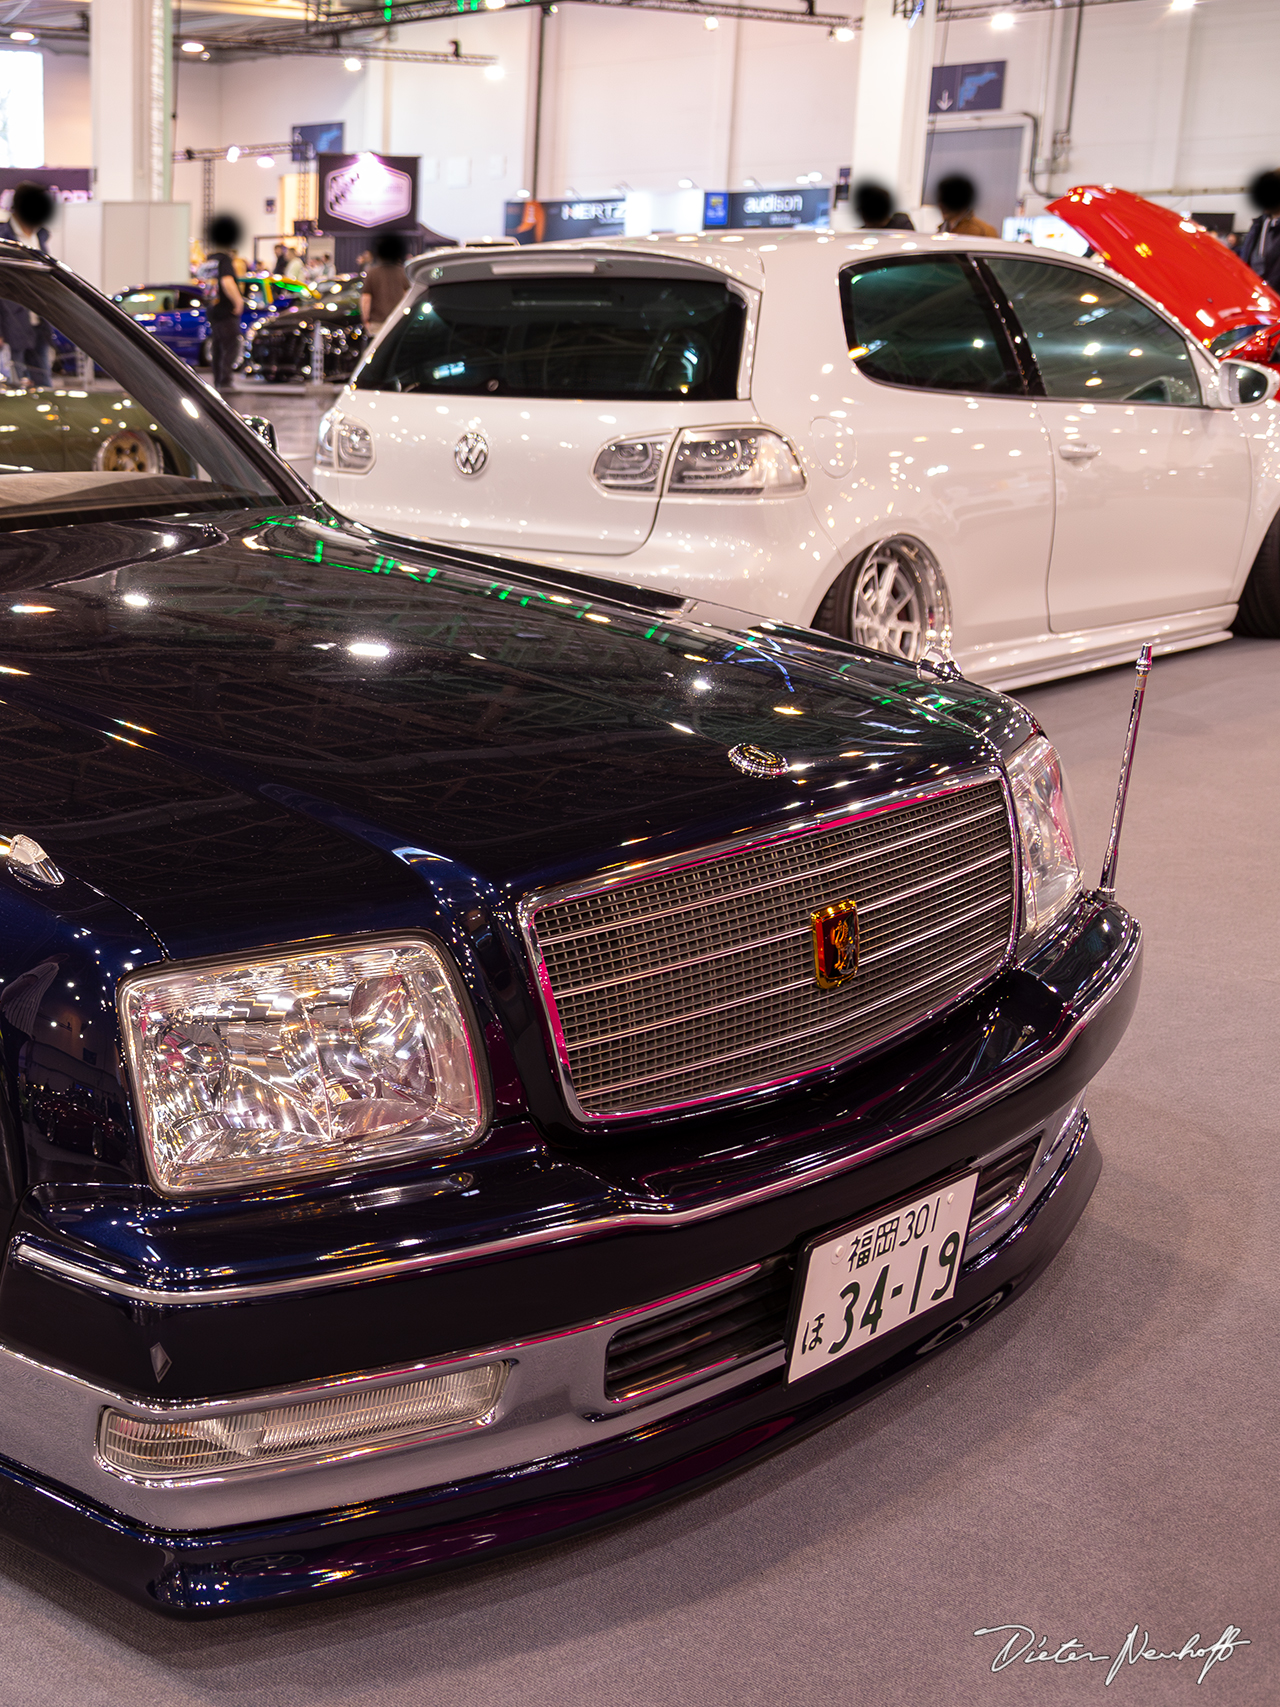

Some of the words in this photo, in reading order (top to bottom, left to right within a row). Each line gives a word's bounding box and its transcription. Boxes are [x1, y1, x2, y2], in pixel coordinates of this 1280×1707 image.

[561, 202, 627, 221] HERTZ
[743, 193, 803, 213] audison
[828, 1231, 961, 1354] 34-19
